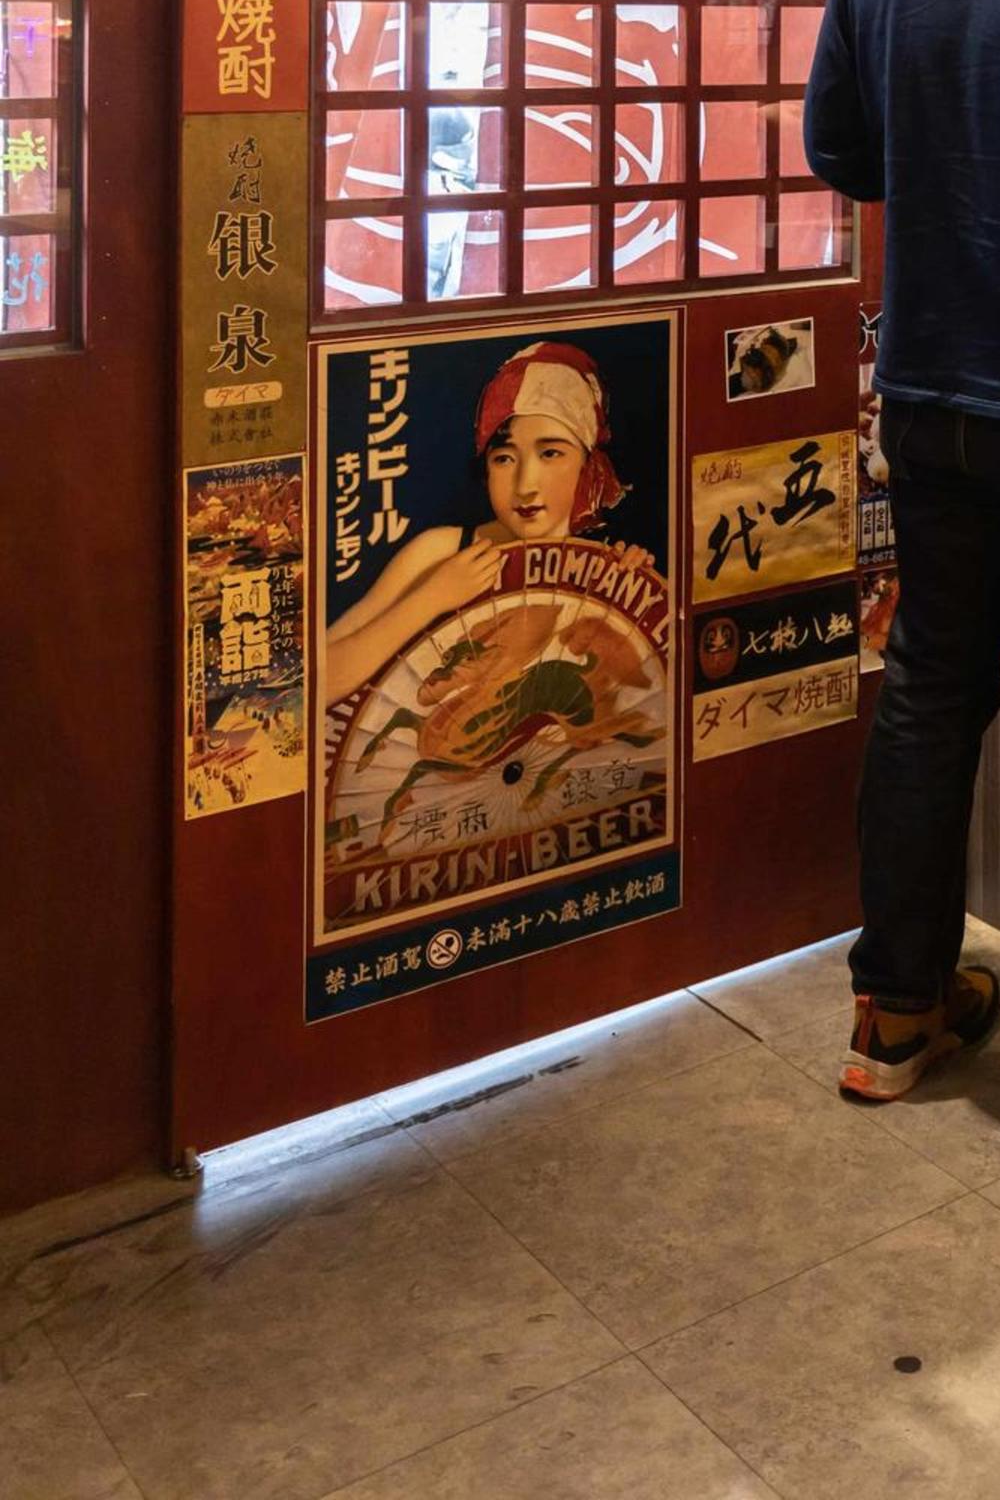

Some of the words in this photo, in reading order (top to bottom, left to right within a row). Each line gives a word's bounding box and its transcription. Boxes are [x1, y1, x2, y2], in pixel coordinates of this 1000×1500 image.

[367, 350, 410, 545] キリンビール
[336, 453, 360, 582] キリンレモン
[696, 670, 856, 740] ダイマ焼酎
[531, 800, 653, 870] BEER
[324, 945, 422, 995] 禁止酒駕
